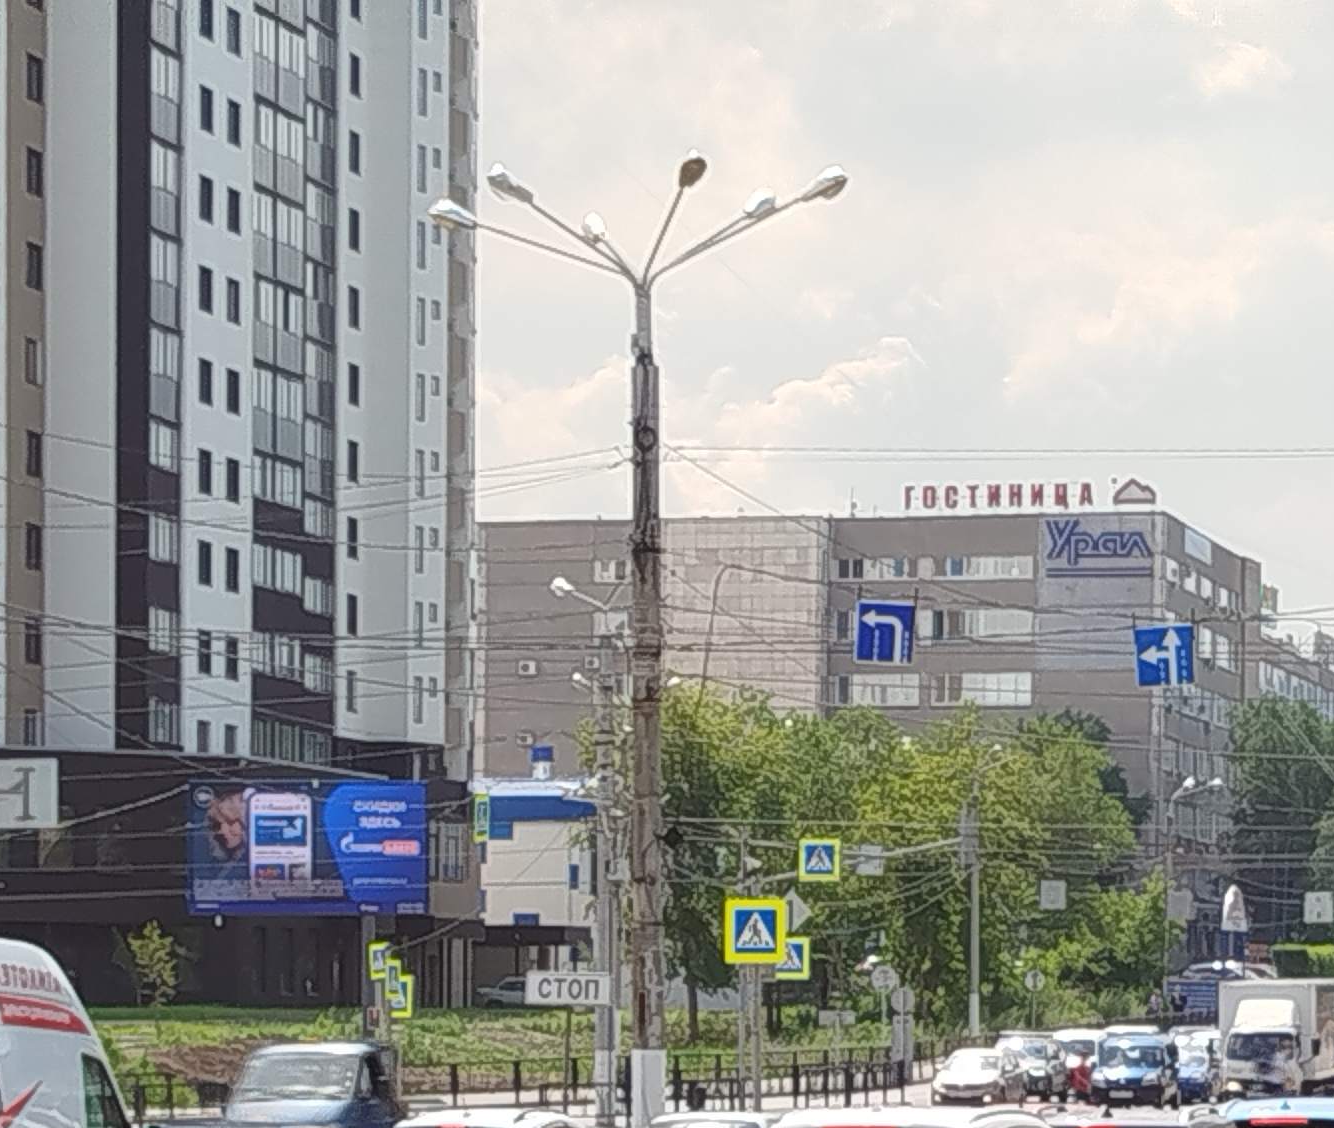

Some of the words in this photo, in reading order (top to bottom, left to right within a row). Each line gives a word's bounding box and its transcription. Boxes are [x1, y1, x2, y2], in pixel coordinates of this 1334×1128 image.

[904, 482, 1094, 511] ГОСТИНИЦА
[1045, 519, 1154, 566] Урал
[538, 977, 600, 1001] СТОП
